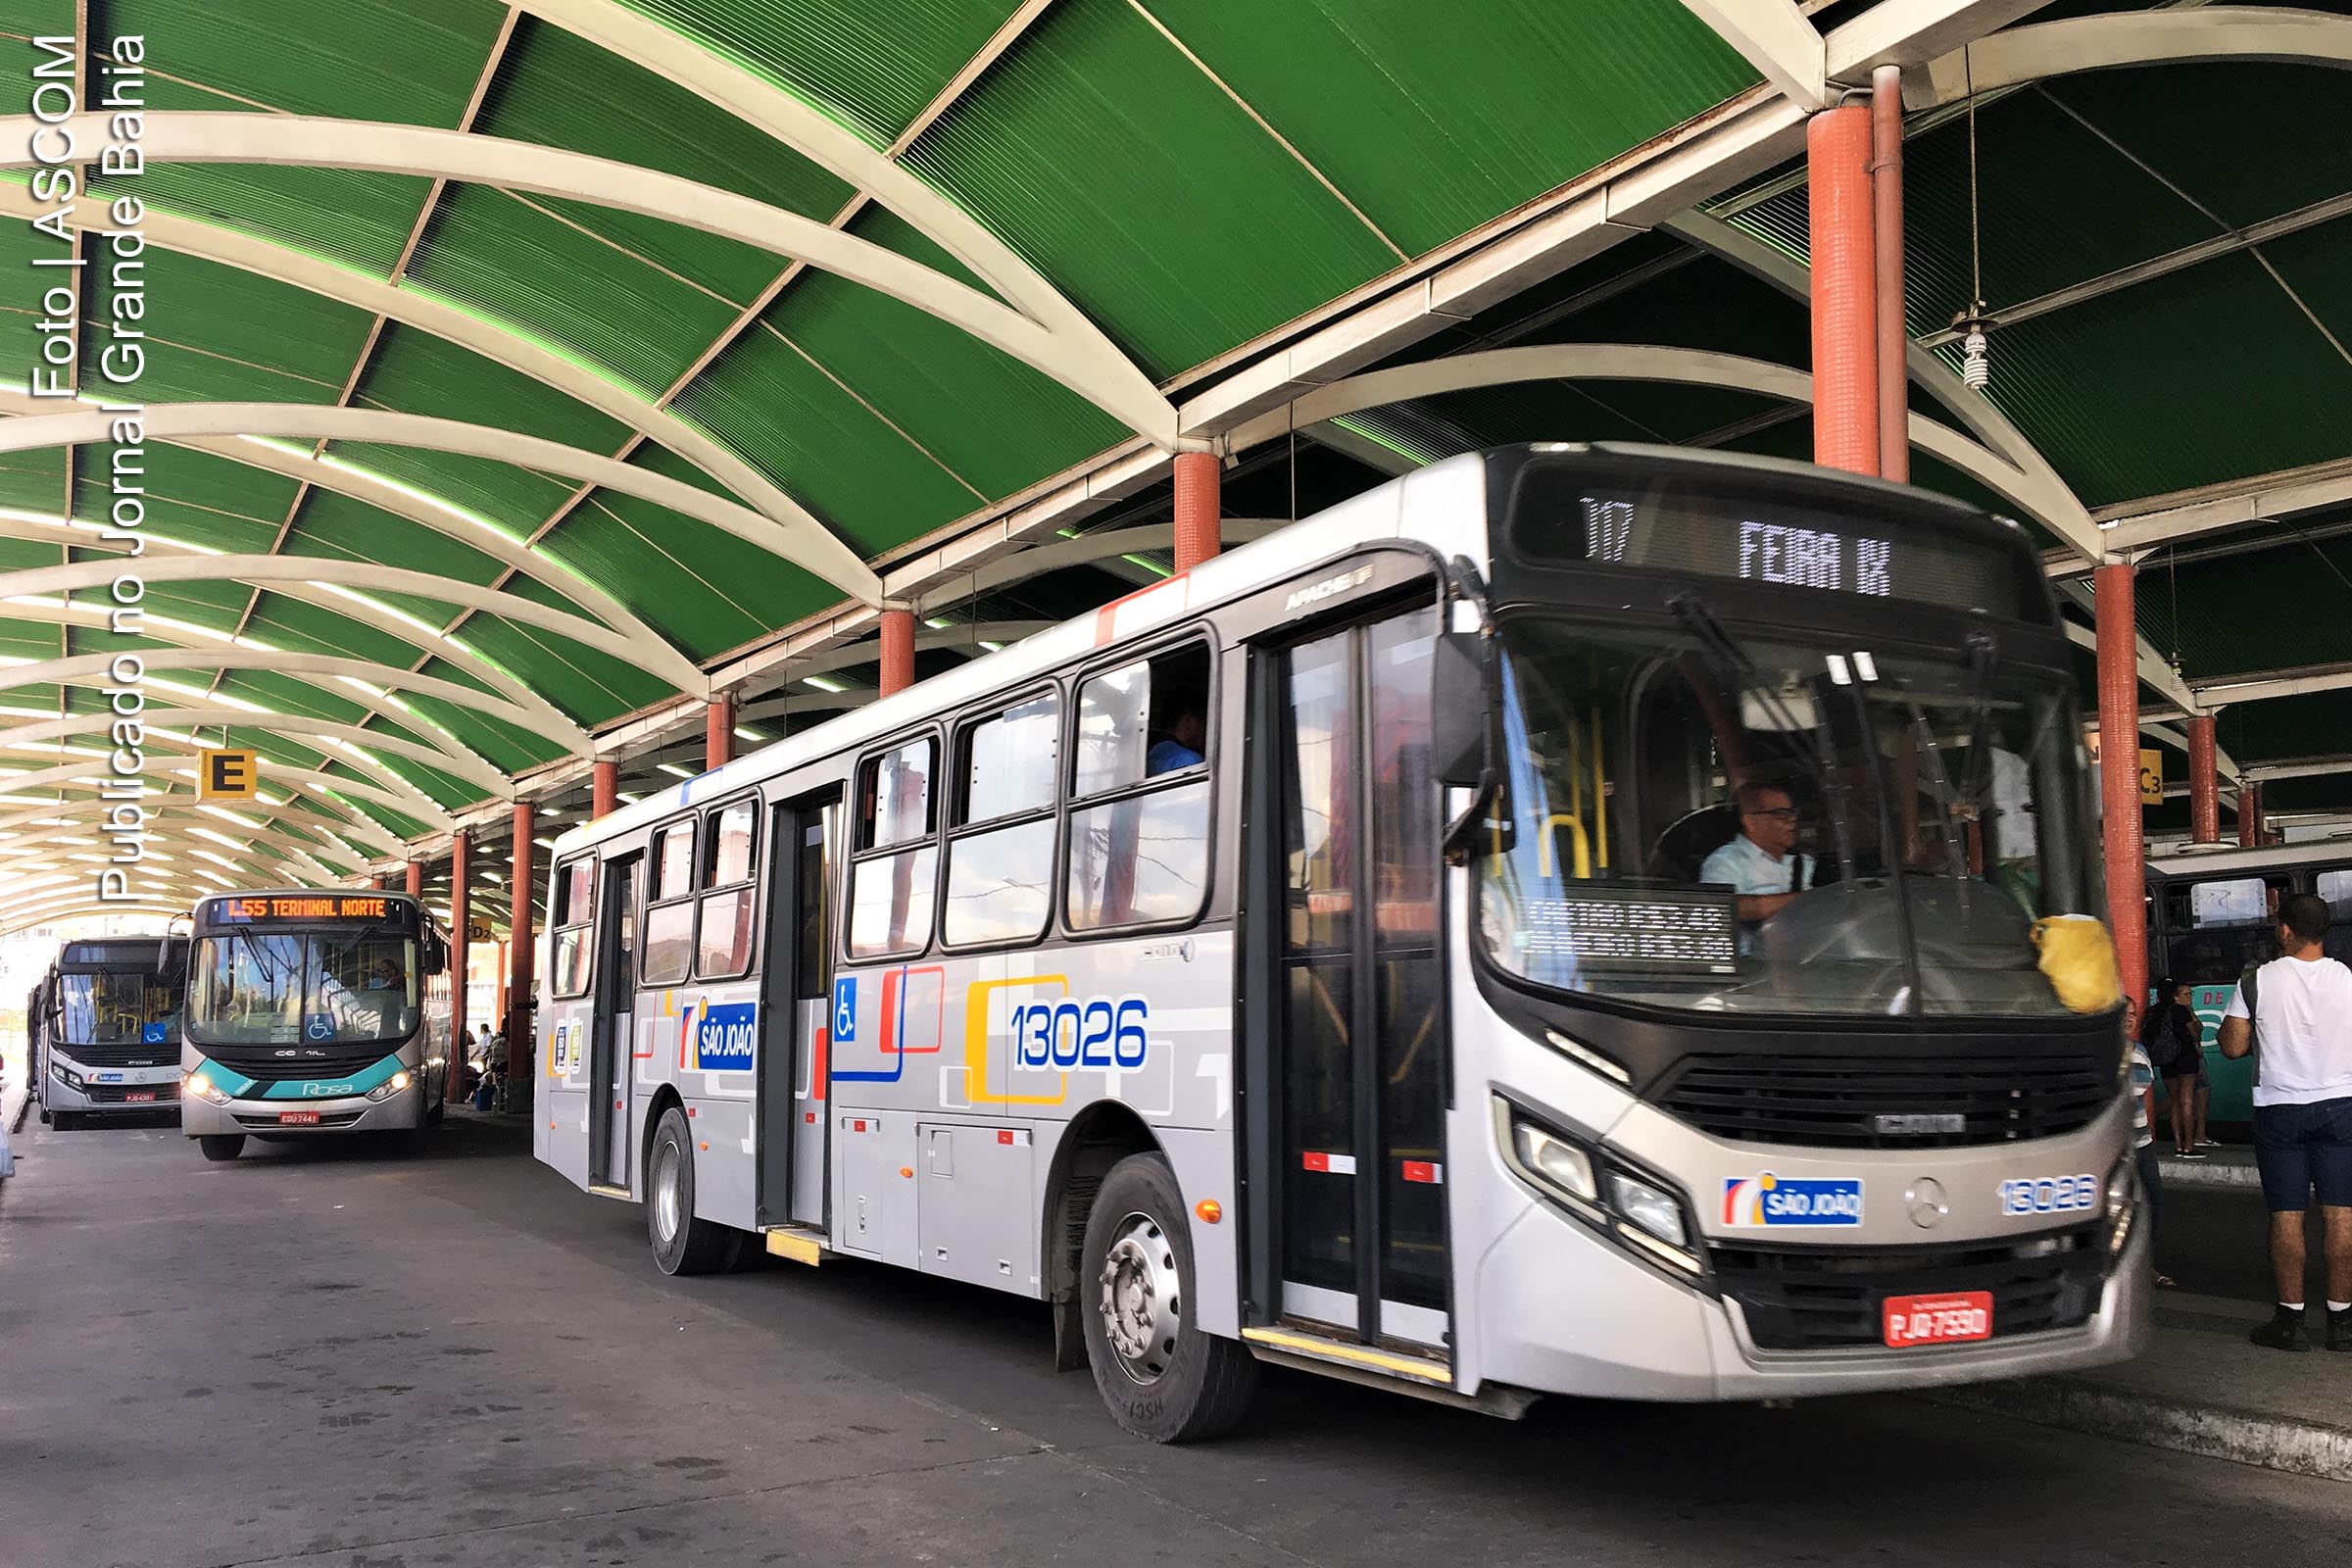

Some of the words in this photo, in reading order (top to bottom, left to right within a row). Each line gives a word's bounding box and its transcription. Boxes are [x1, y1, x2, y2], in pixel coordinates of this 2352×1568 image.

[1740, 521, 1840, 590] FEIRA
[212, 755, 246, 791] E
[2139, 767, 2161, 794] C3
[228, 899, 268, 917] L55
[271, 899, 337, 917] TERMINAL
[341, 899, 387, 917] NORTE
[473, 926, 490, 939] D2
[700, 1016, 723, 1056] SÃO
[722, 1014, 754, 1056] JOÃO
[1010, 999, 1149, 1068] 13026
[303, 1082, 353, 1097] Rosa
[1766, 1188, 1810, 1216] SÃO
[1809, 1188, 1861, 1217] JOÃO
[1997, 1174, 2096, 1214] 13026
